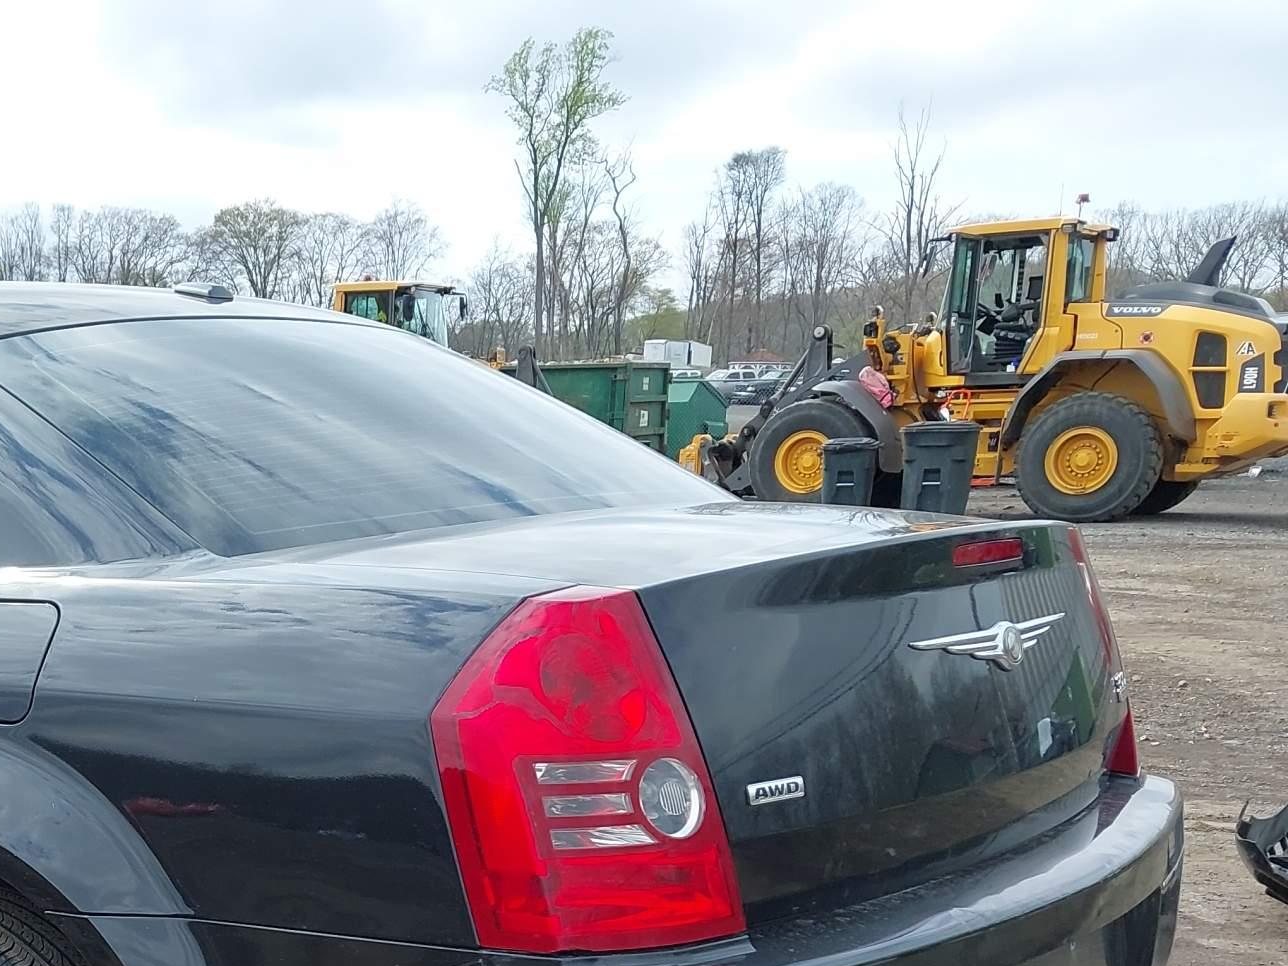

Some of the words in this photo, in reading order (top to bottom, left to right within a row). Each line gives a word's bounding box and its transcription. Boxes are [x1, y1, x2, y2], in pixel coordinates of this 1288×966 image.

[1112, 306, 1162, 314] VOLVO
[1243, 367, 1259, 389] L90H
[754, 781, 800, 800] AWD
